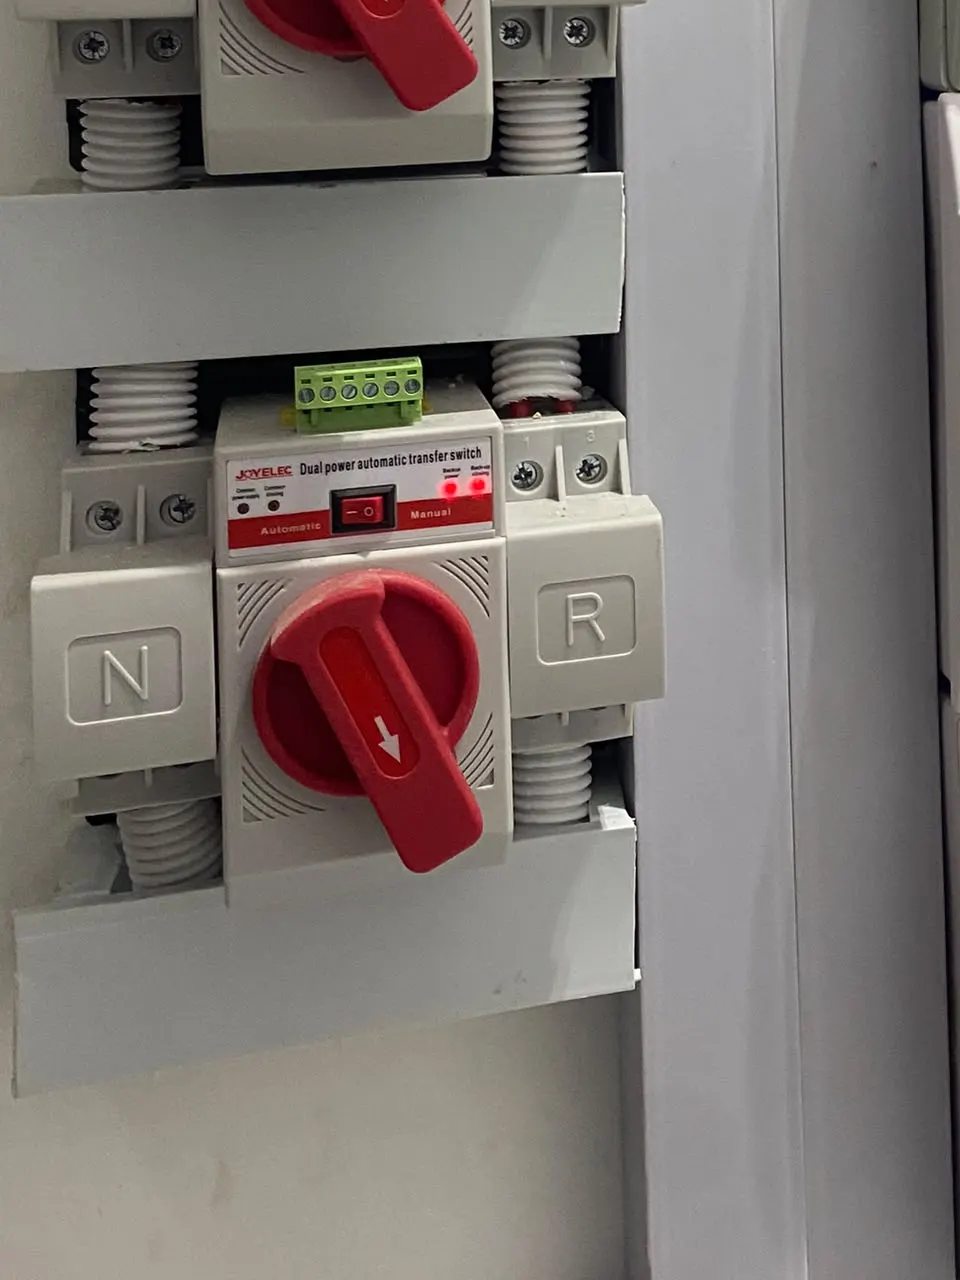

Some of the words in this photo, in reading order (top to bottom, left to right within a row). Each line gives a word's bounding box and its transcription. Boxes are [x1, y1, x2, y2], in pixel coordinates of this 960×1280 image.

[299, 461, 323, 476] Dual
[325, 460, 355, 476] power
[357, 454, 408, 470] automatic
[409, 449, 449, 465] transfer
[450, 446, 482, 461] switch
[235, 465, 293, 481] JOYELEC
[411, 507, 451, 520] Manual
[260, 522, 322, 536] Automatic
[566, 591, 605, 646] R
[102, 645, 148, 705] N
